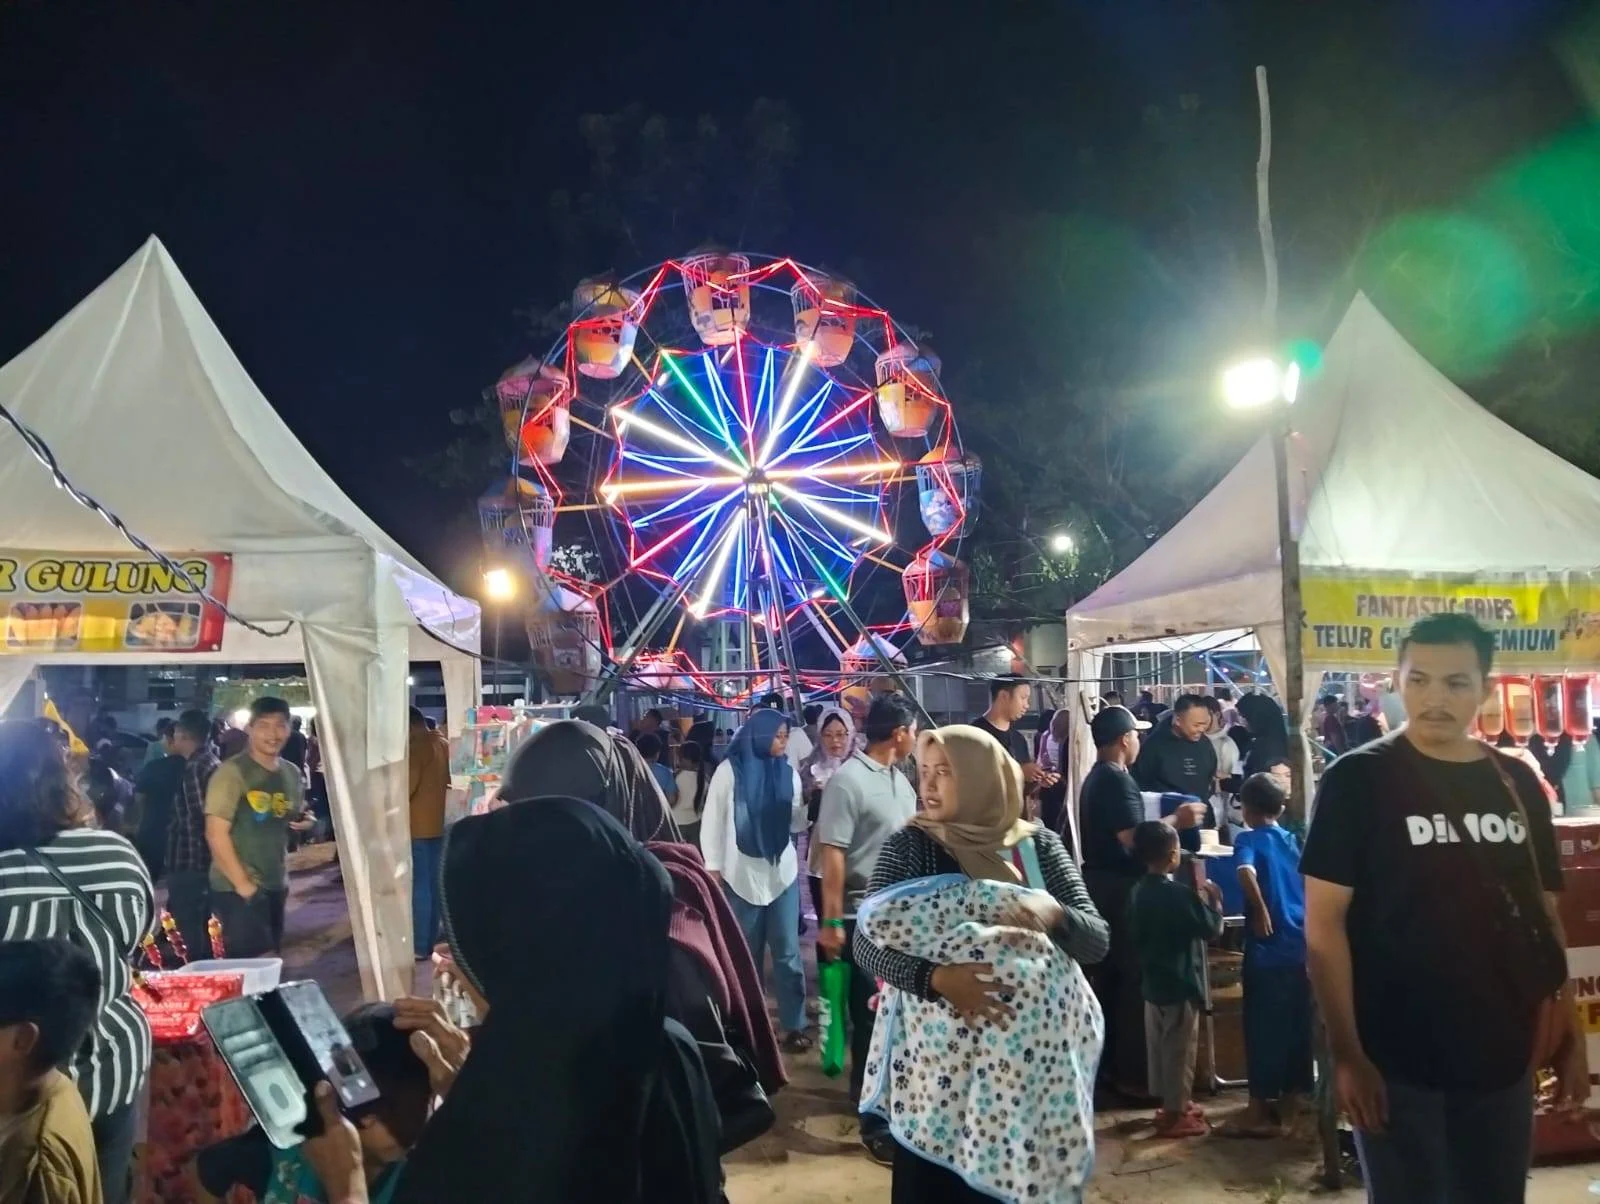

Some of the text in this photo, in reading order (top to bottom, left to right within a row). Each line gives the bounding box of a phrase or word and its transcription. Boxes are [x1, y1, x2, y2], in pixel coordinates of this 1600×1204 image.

[25, 559, 207, 593] GULUNG
[1313, 624, 1373, 649] TELUR
[1493, 629, 1556, 651] EMIUM
